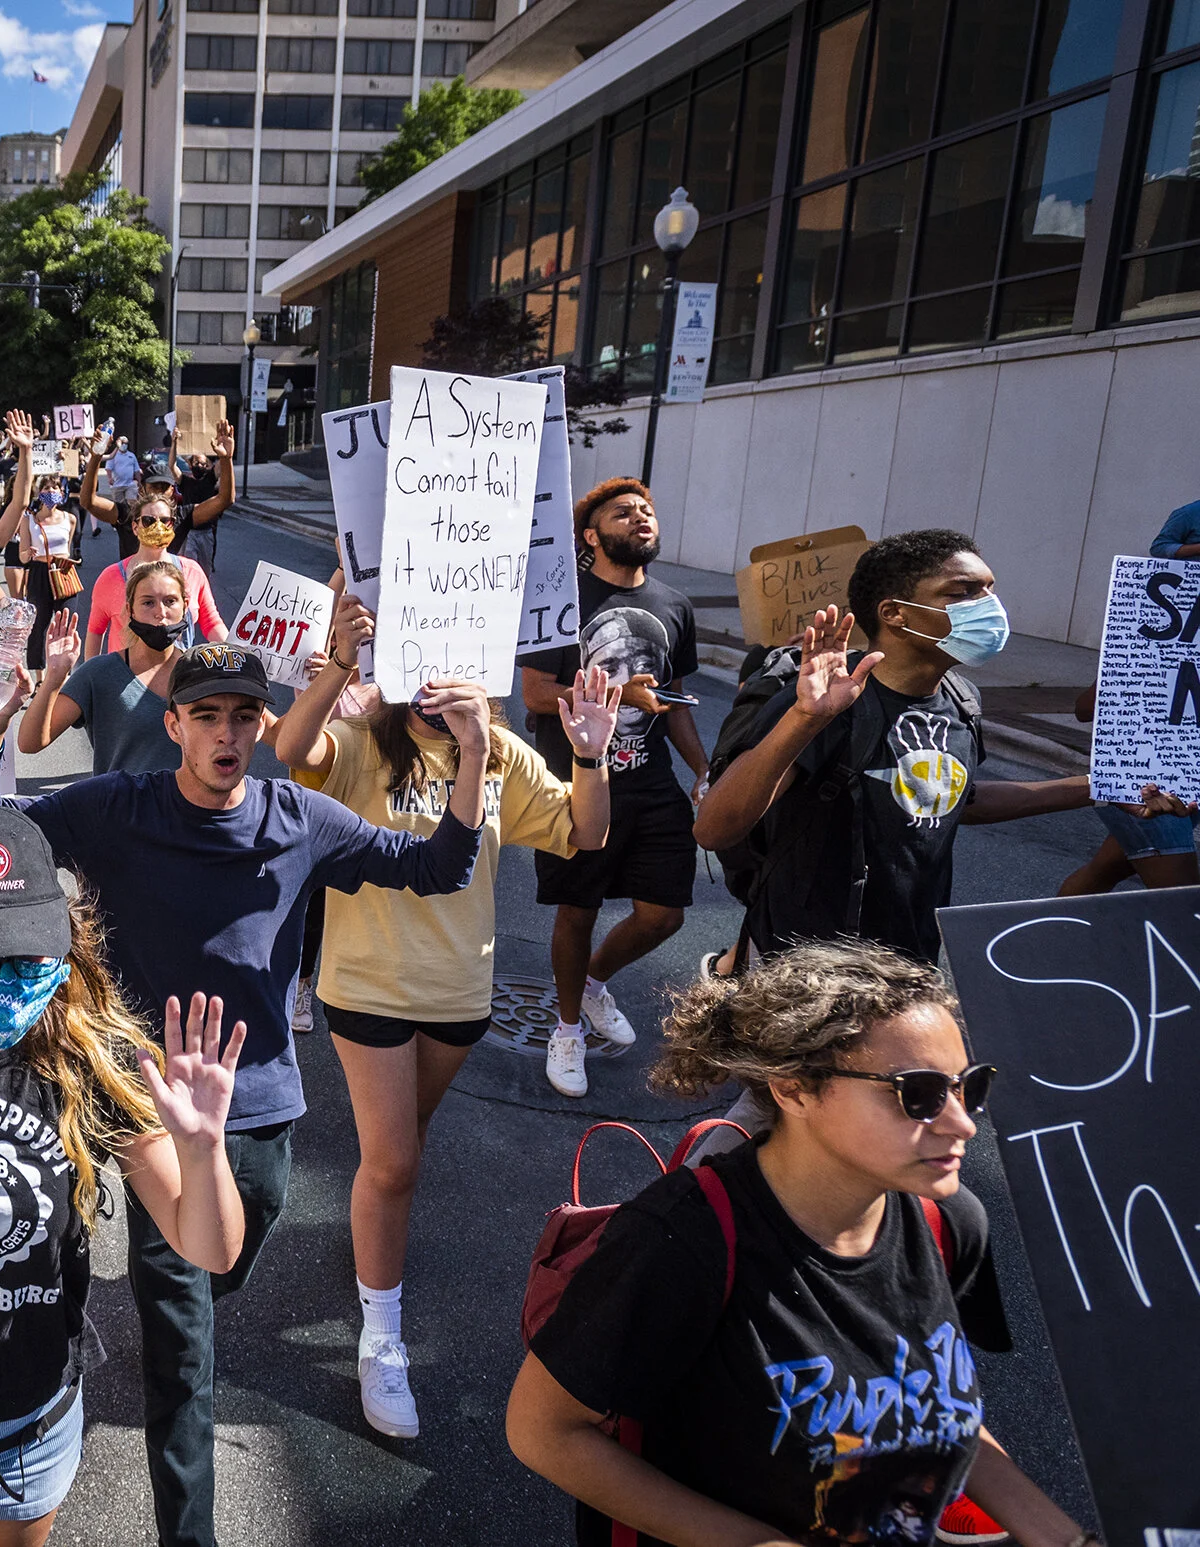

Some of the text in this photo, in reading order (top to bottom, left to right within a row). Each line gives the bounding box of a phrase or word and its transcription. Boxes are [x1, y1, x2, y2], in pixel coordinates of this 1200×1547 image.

[59, 408, 93, 433] BLM
[404, 377, 435, 447] A
[447, 376, 537, 449] System
[394, 451, 518, 501] Cannot fail
[430, 504, 492, 543] those
[394, 538, 414, 585] it
[1115, 568, 1131, 579] Eric
[1116, 557, 1144, 572] George
[249, 571, 324, 626] Justice
[399, 601, 487, 632] Meant to
[785, 580, 842, 605] Lives
[235, 609, 311, 658] CAN'T
[197, 644, 247, 672] WF
[401, 638, 488, 690] Protect
[985, 915, 1200, 1094] SA
[1006, 1119, 1200, 1312] Th
[764, 1333, 934, 1457] Purple
